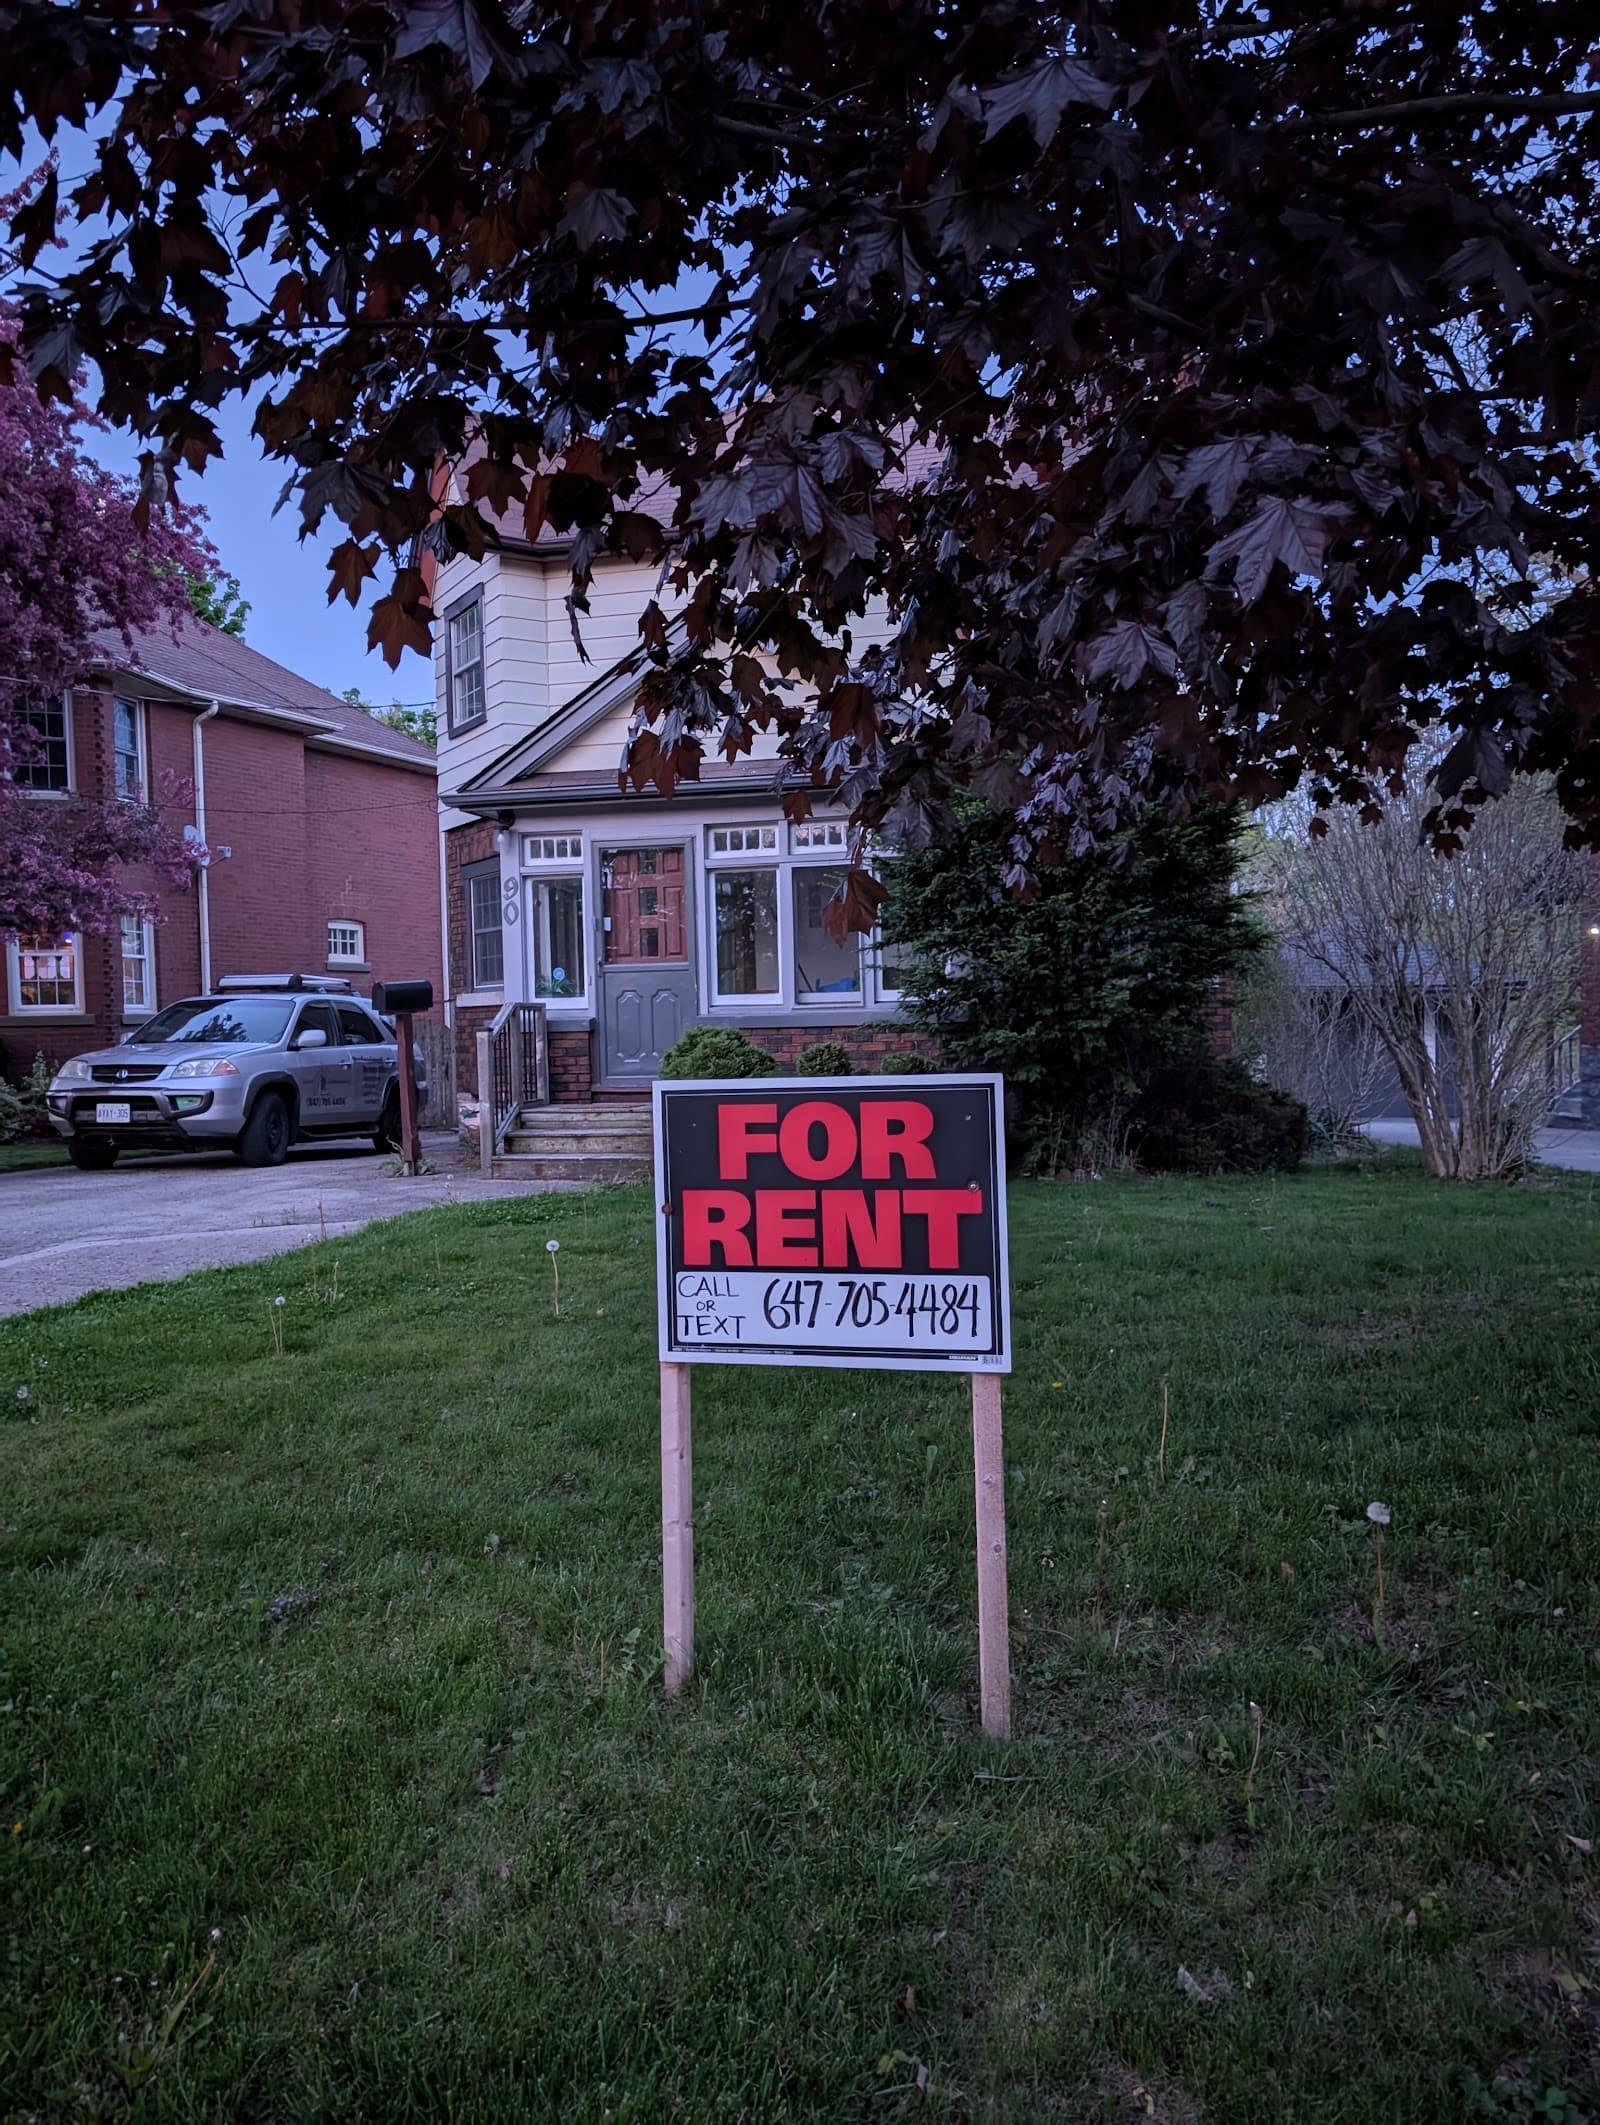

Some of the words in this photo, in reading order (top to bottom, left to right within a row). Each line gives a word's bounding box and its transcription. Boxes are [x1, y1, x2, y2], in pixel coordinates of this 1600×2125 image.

[503, 876, 519, 926] 90
[718, 1101, 937, 1181] FOR
[682, 1189, 983, 1269] RENT
[677, 1275, 740, 1298] CALL
[696, 1299, 717, 1313] OR
[763, 1278, 980, 1338] 647-705-4484
[677, 1315, 746, 1339] TEXT
